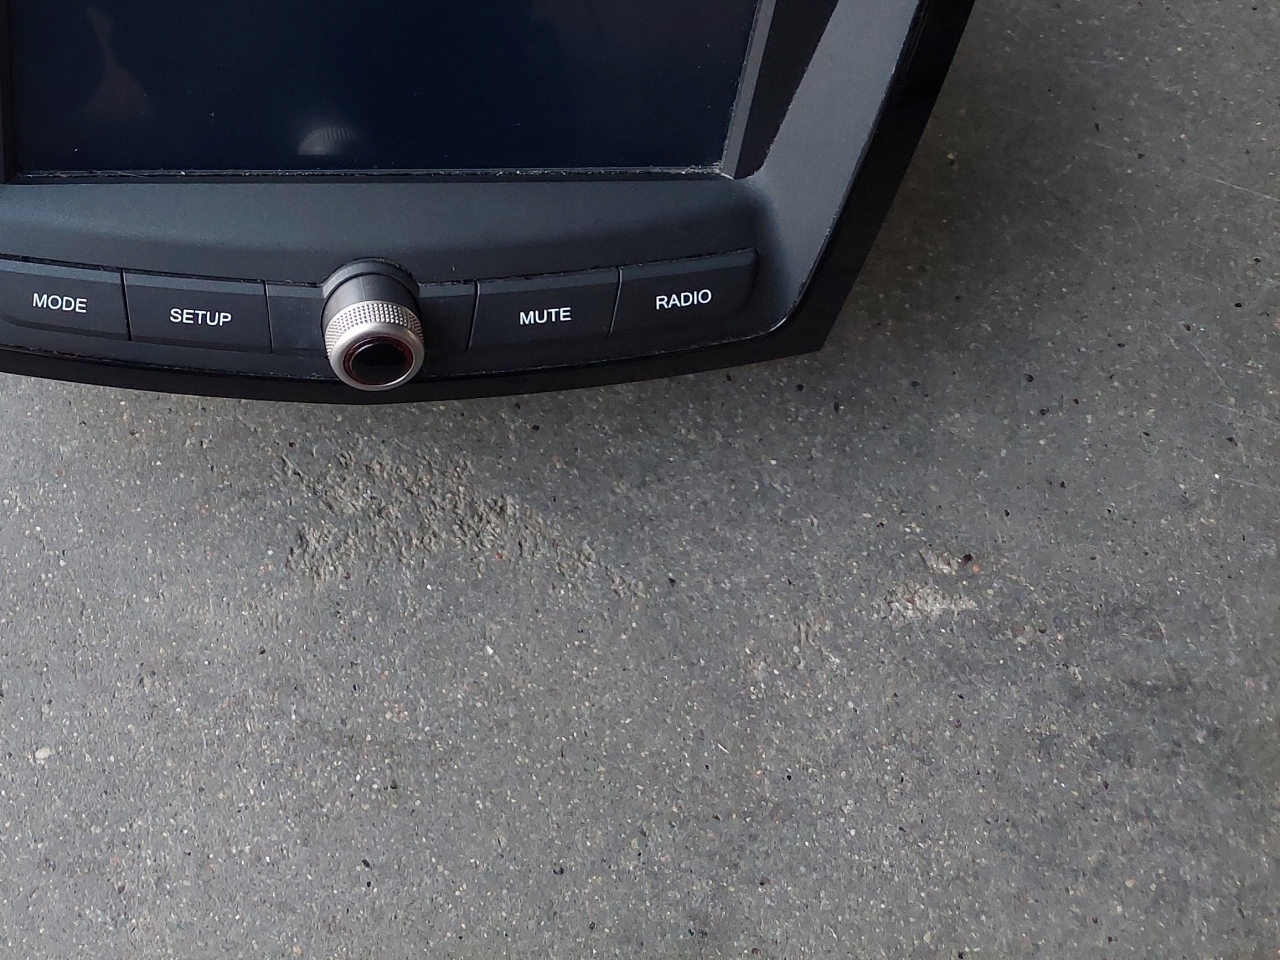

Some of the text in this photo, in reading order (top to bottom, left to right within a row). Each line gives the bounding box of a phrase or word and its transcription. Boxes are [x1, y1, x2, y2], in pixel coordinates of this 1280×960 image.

[31, 291, 88, 314] MODE
[654, 289, 713, 312] RADIO
[168, 307, 233, 327] SETUP
[518, 306, 572, 326] MUTE
